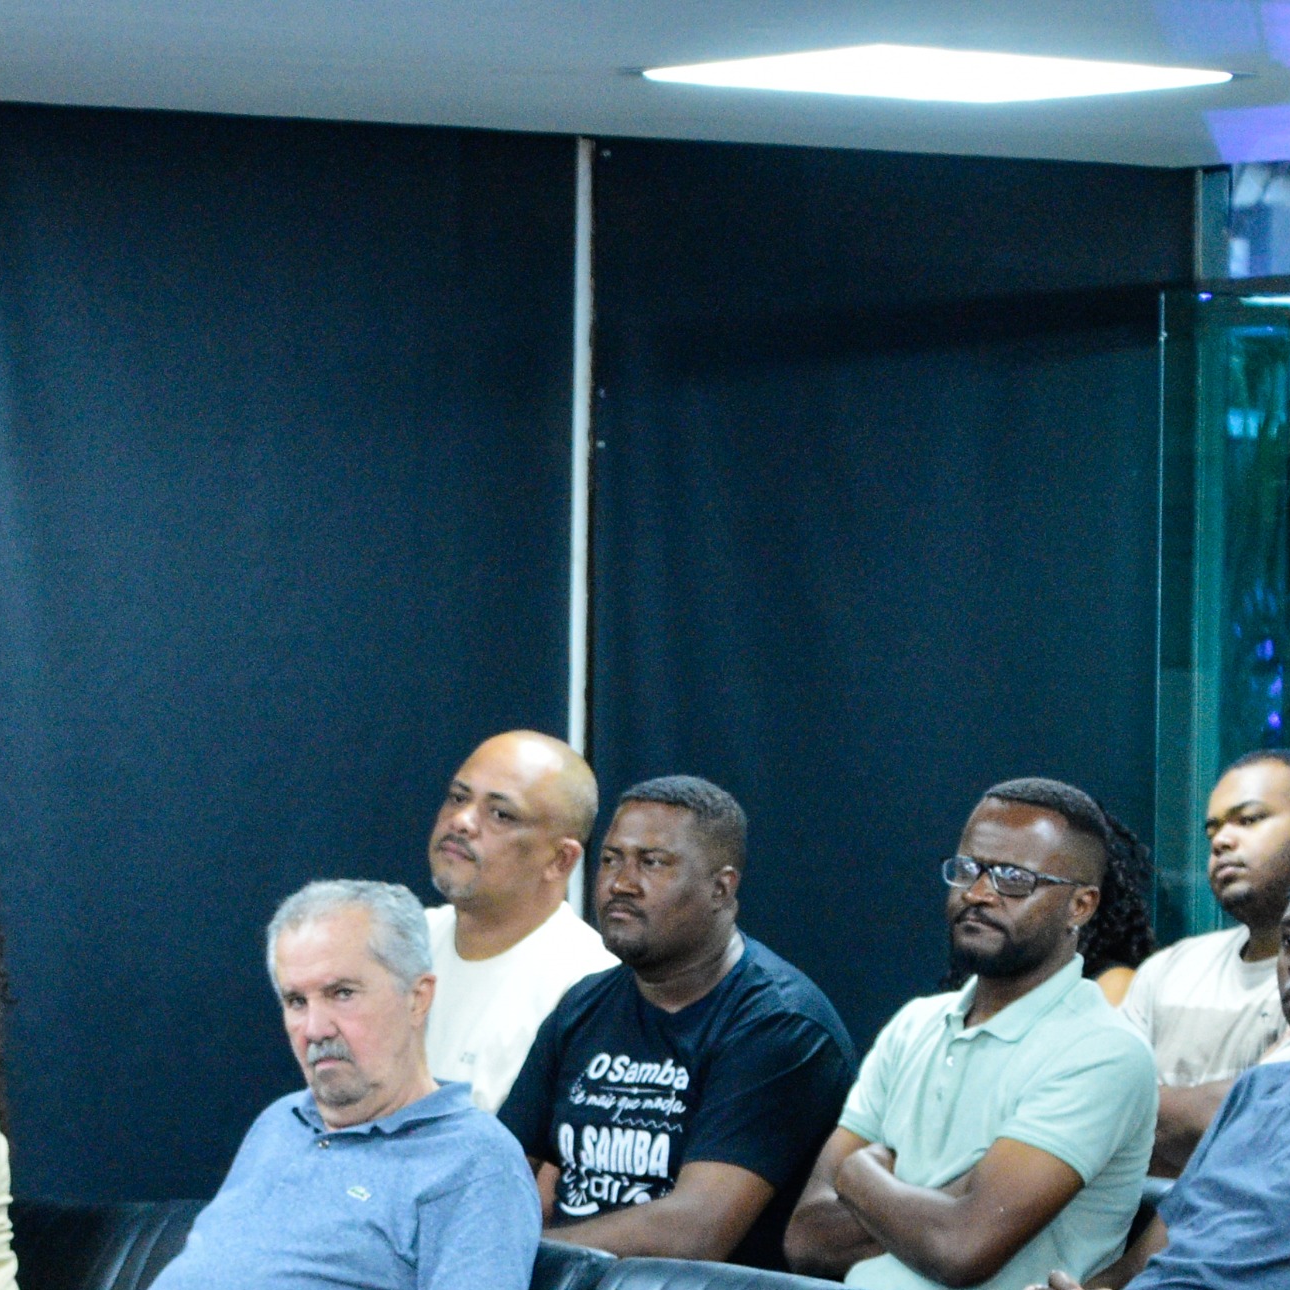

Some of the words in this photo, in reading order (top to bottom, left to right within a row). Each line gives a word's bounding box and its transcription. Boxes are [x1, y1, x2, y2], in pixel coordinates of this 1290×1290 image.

[586, 1053, 610, 1080] O
[607, 1055, 689, 1090] Samba
[580, 1124, 670, 1178] SAMBA
